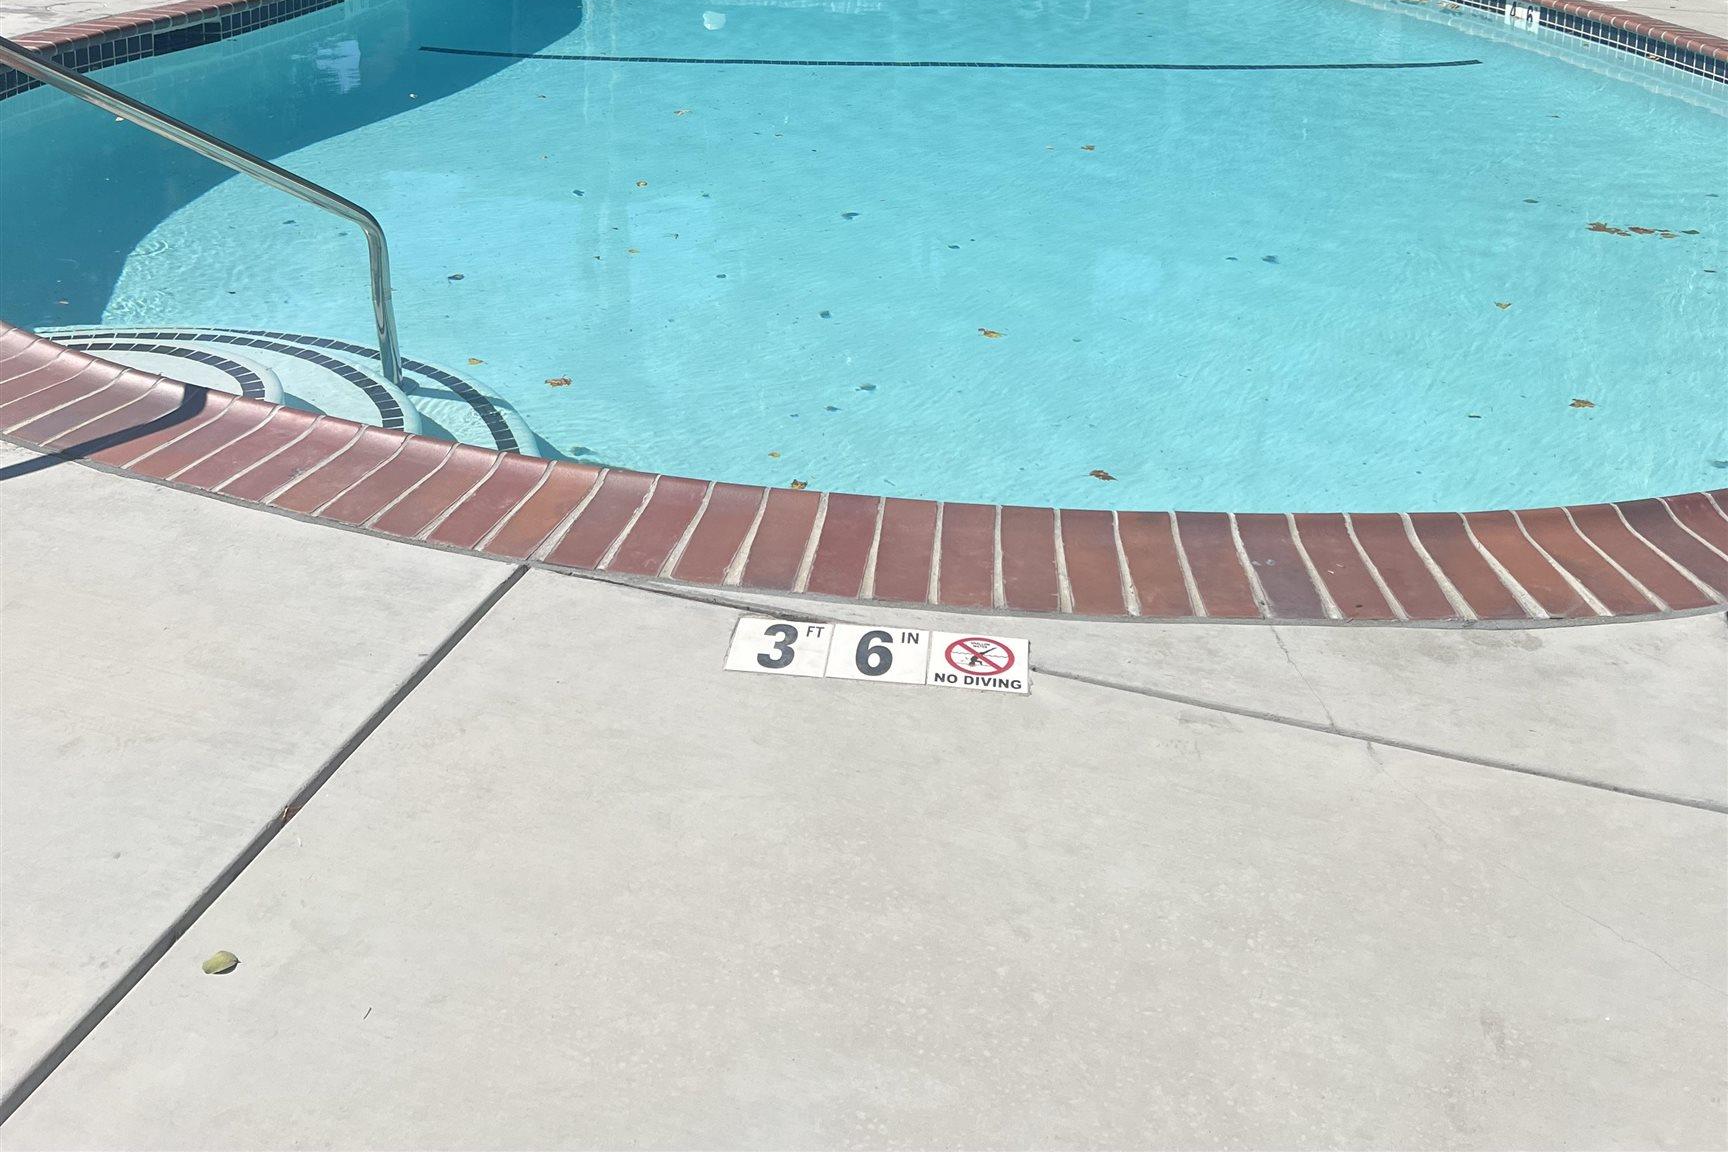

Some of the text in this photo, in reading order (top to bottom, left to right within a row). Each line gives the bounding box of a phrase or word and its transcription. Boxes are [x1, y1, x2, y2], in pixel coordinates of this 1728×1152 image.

[756, 623, 919, 676] 3 FT 6 IN
[934, 672, 1022, 690] NO DIVING
